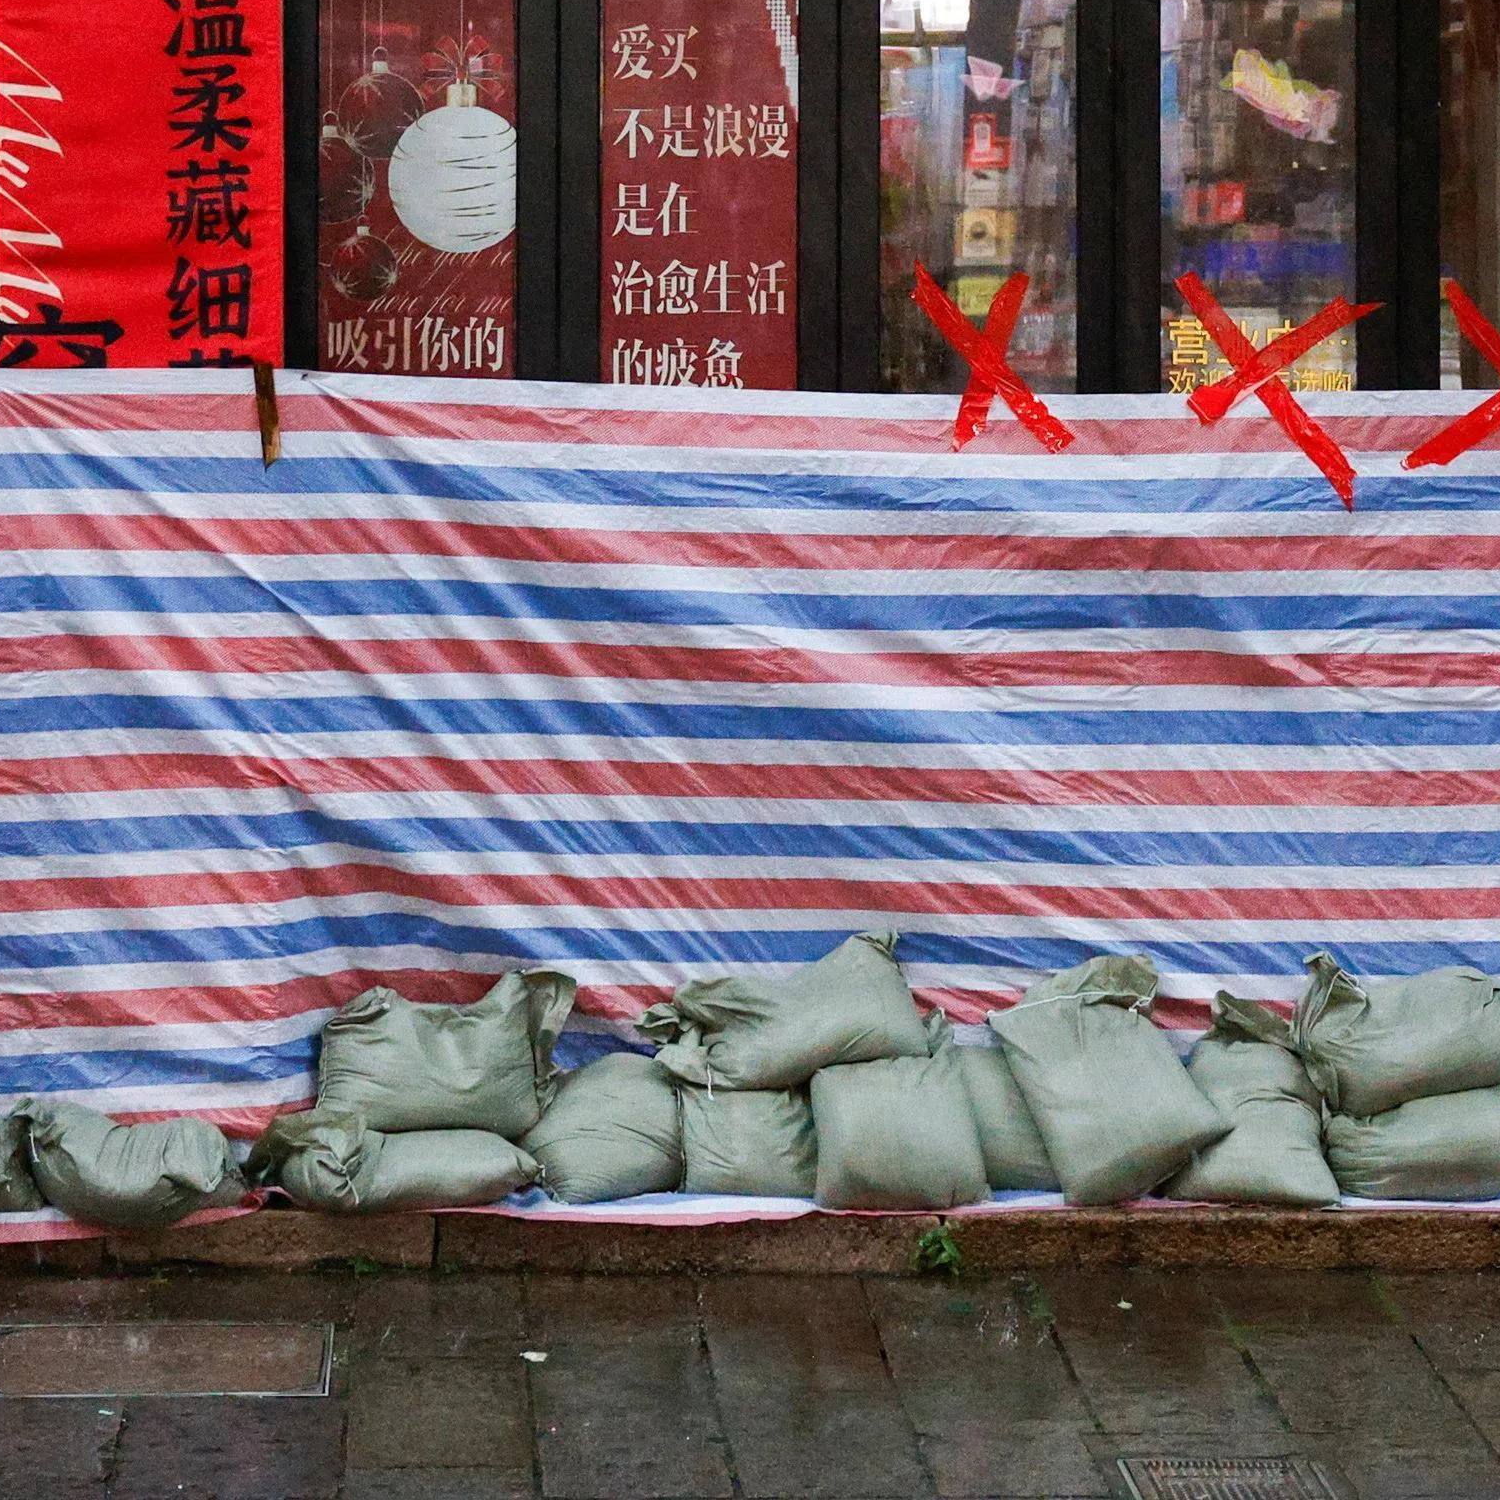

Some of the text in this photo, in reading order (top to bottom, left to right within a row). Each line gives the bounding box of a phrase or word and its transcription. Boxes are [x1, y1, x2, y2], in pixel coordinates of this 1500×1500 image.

[611, 23, 699, 81] 爱买
[612, 102, 791, 160] 不是浪漫
[611, 181, 699, 238] 是在
[611, 258, 789, 316] 治愈生活
[327, 316, 505, 373] 吸引你的
